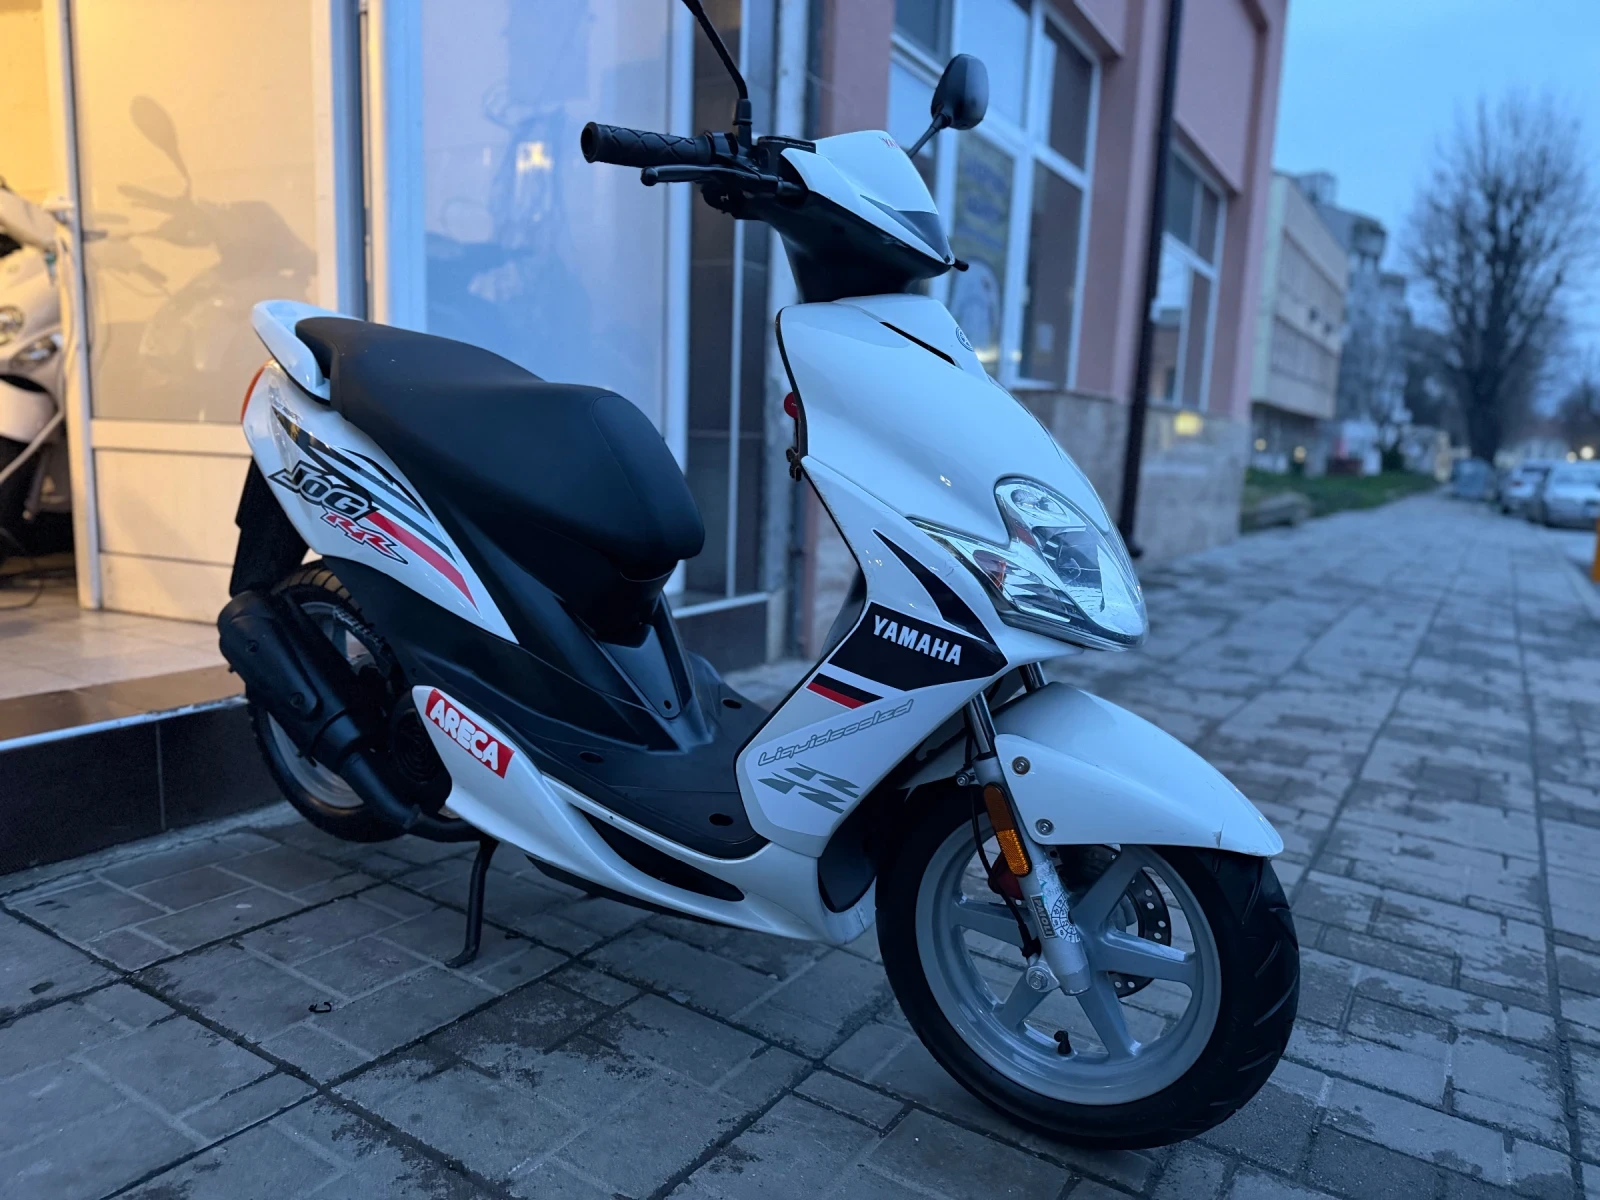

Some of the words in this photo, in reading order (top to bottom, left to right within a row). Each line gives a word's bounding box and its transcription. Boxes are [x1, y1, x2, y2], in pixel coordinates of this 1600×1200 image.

[268, 460, 377, 520] JOG
[873, 614, 962, 666] YAMAHA
[429, 698, 499, 771] ARECA
[757, 698, 914, 766] Liquidcooled
